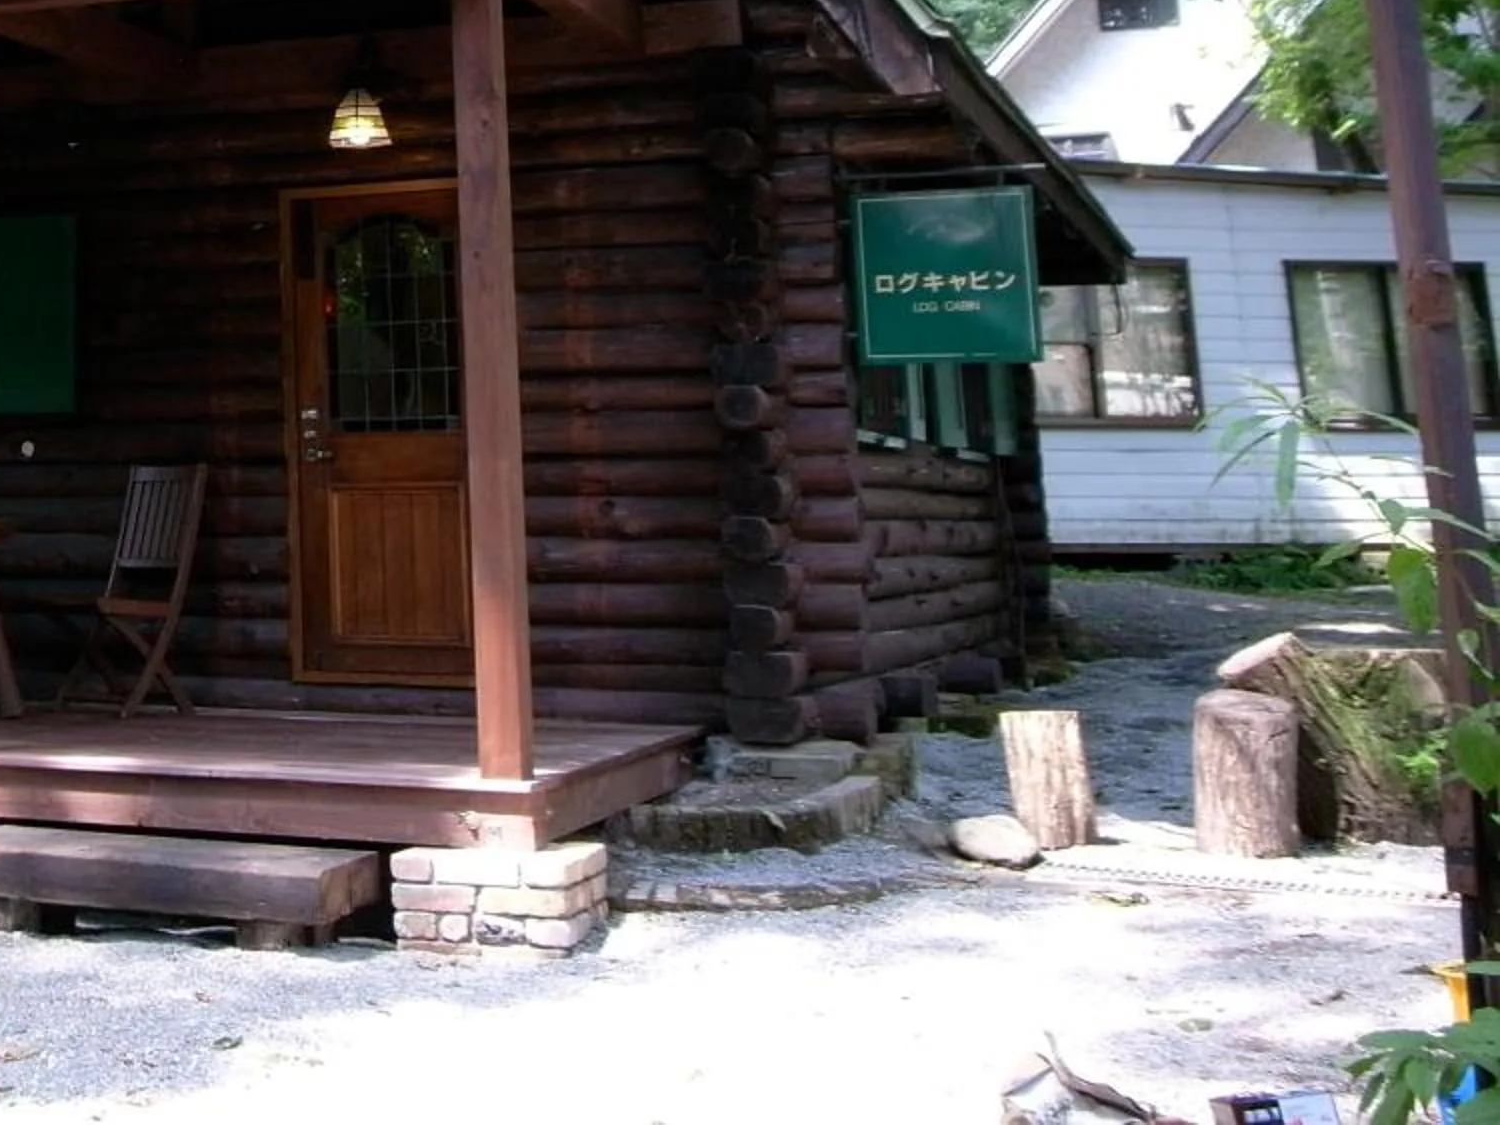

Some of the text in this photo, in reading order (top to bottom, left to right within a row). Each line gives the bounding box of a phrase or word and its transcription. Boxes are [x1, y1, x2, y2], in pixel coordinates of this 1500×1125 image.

[875, 271, 1016, 293] ログキャビン
